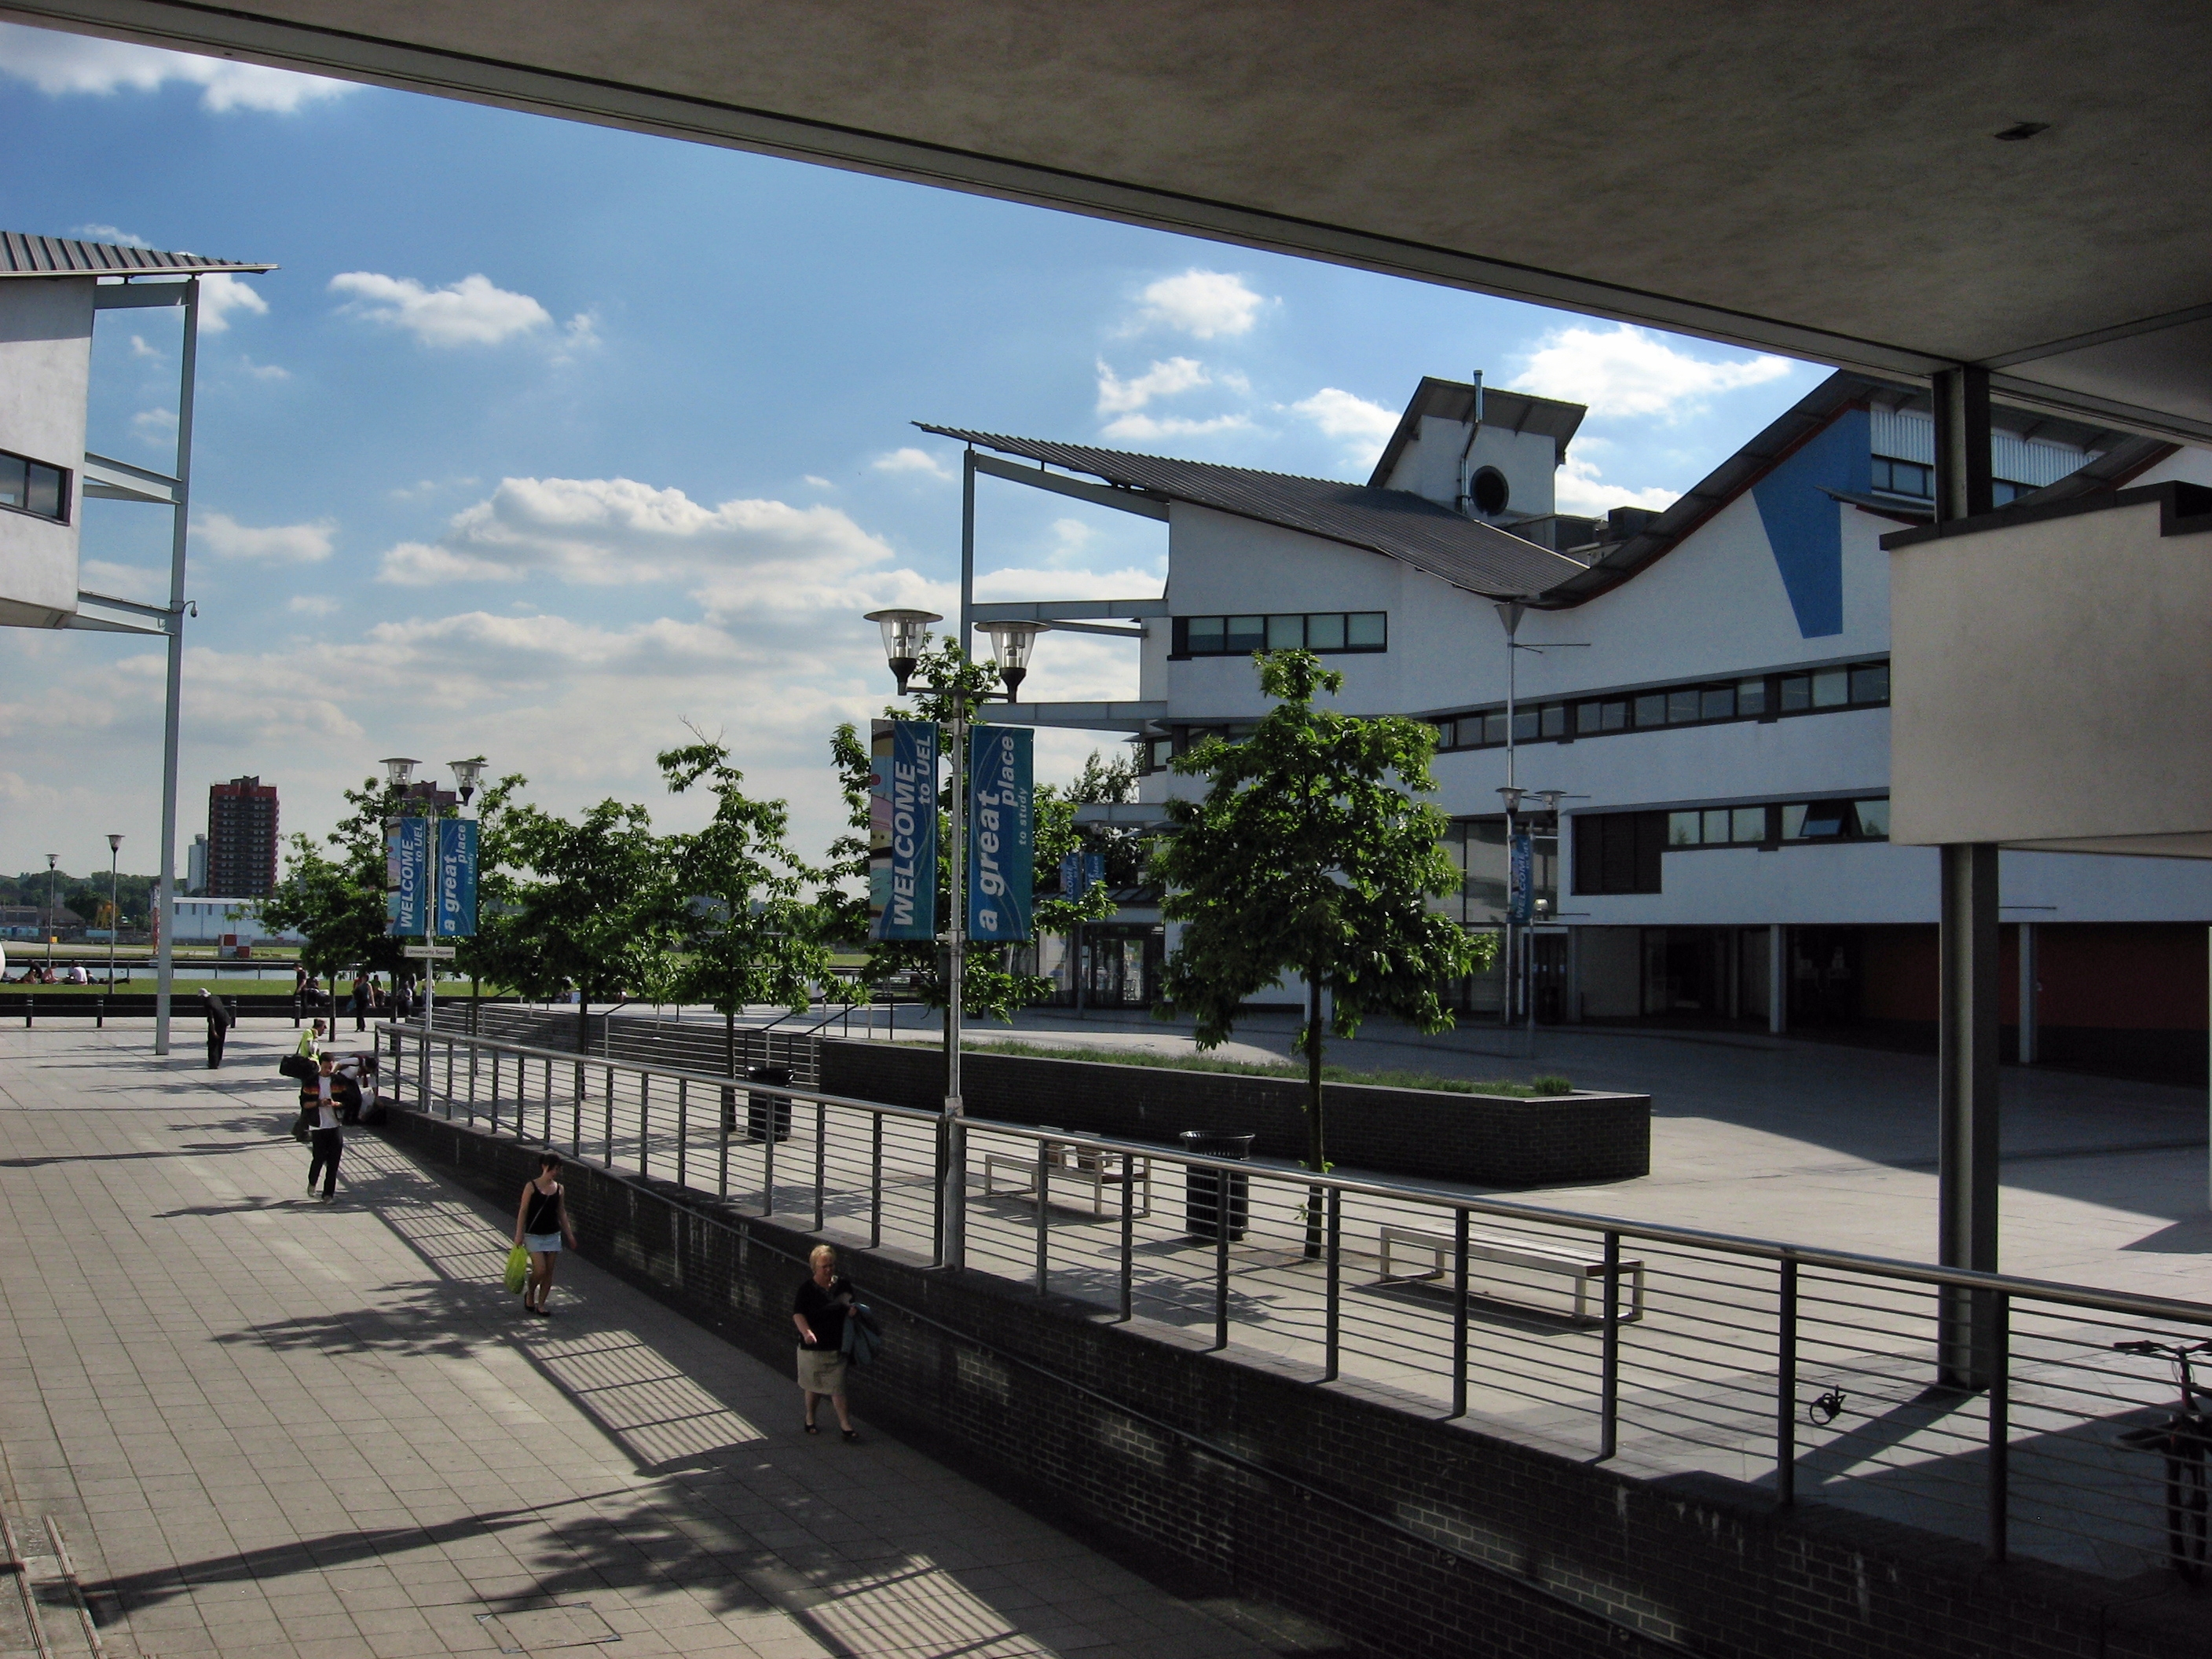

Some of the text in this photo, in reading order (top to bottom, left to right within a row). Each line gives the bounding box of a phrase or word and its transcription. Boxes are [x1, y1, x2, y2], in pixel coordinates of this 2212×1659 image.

[916, 735, 931, 804] to UEL
[998, 736, 1019, 807] place
[413, 826, 423, 862] to UEL
[456, 825, 468, 864] place
[893, 761, 916, 925] WELCOME
[1018, 787, 1028, 845] to study
[401, 840, 414, 928] WELCOME
[444, 855, 460, 932] a great
[976, 789, 1005, 932] a great
[1516, 855, 1526, 918] WELCOME
